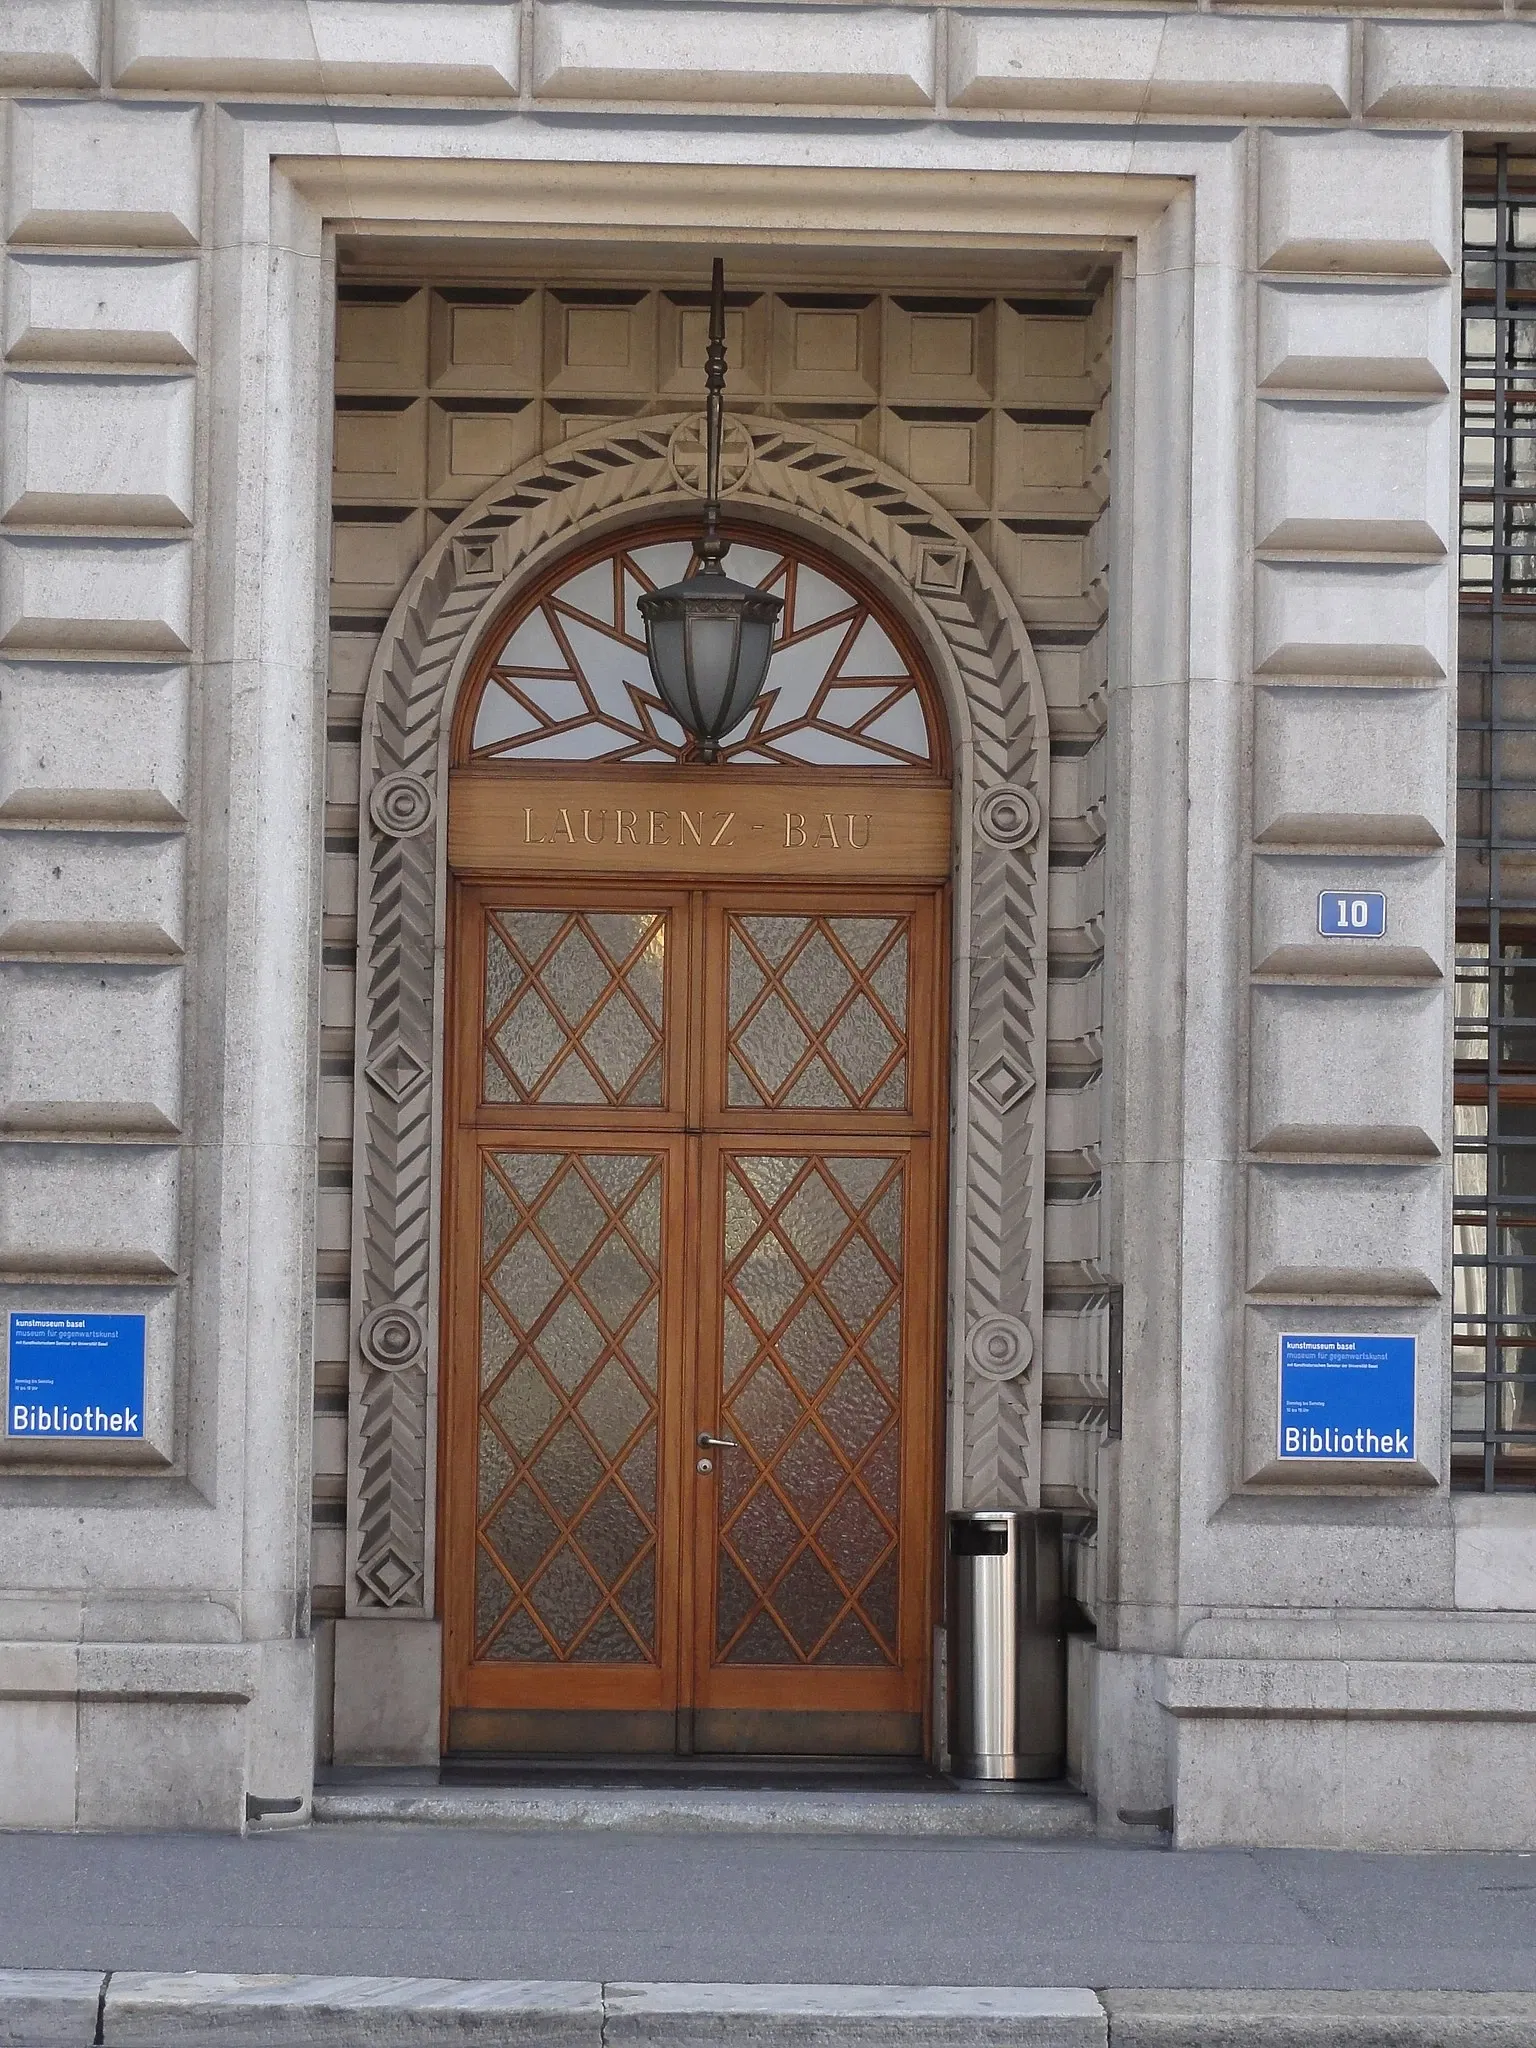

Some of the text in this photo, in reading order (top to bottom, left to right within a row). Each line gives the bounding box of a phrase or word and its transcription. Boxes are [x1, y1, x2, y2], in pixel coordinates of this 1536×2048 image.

[523, 807, 737, 847] LAURENZ
[782, 812, 873, 849] BAU
[1337, 900, 1368, 927] 10
[15, 1319, 86, 1328] kunstmuseum basel
[1286, 1341, 1356, 1350] kunstmuseum basel
[14, 1405, 139, 1432] Bibliothek
[1285, 1427, 1409, 1454] Bibliothek
